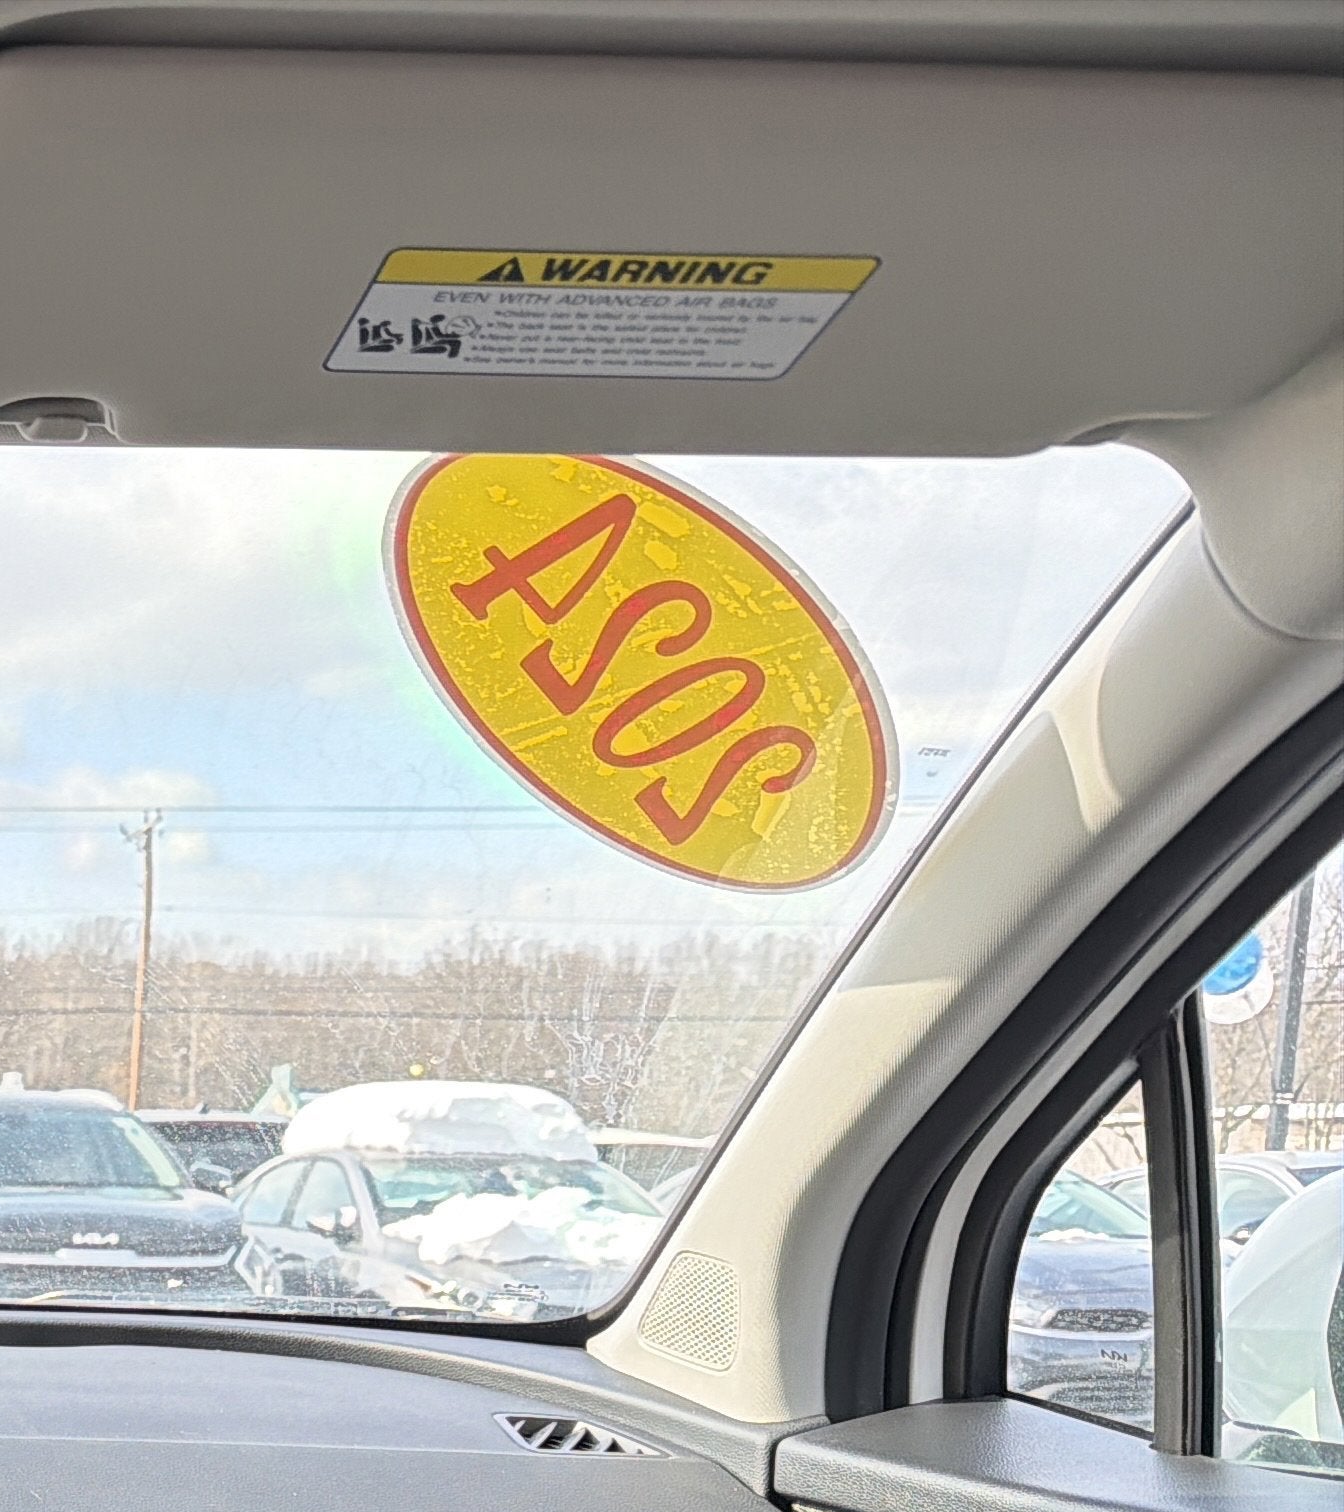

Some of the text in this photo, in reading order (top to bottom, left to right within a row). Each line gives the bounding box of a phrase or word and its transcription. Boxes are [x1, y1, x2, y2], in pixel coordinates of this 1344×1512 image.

[541, 258, 774, 285] WARNING
[433, 290, 779, 309] EVEN WITH ADVANCED AIR BAGS
